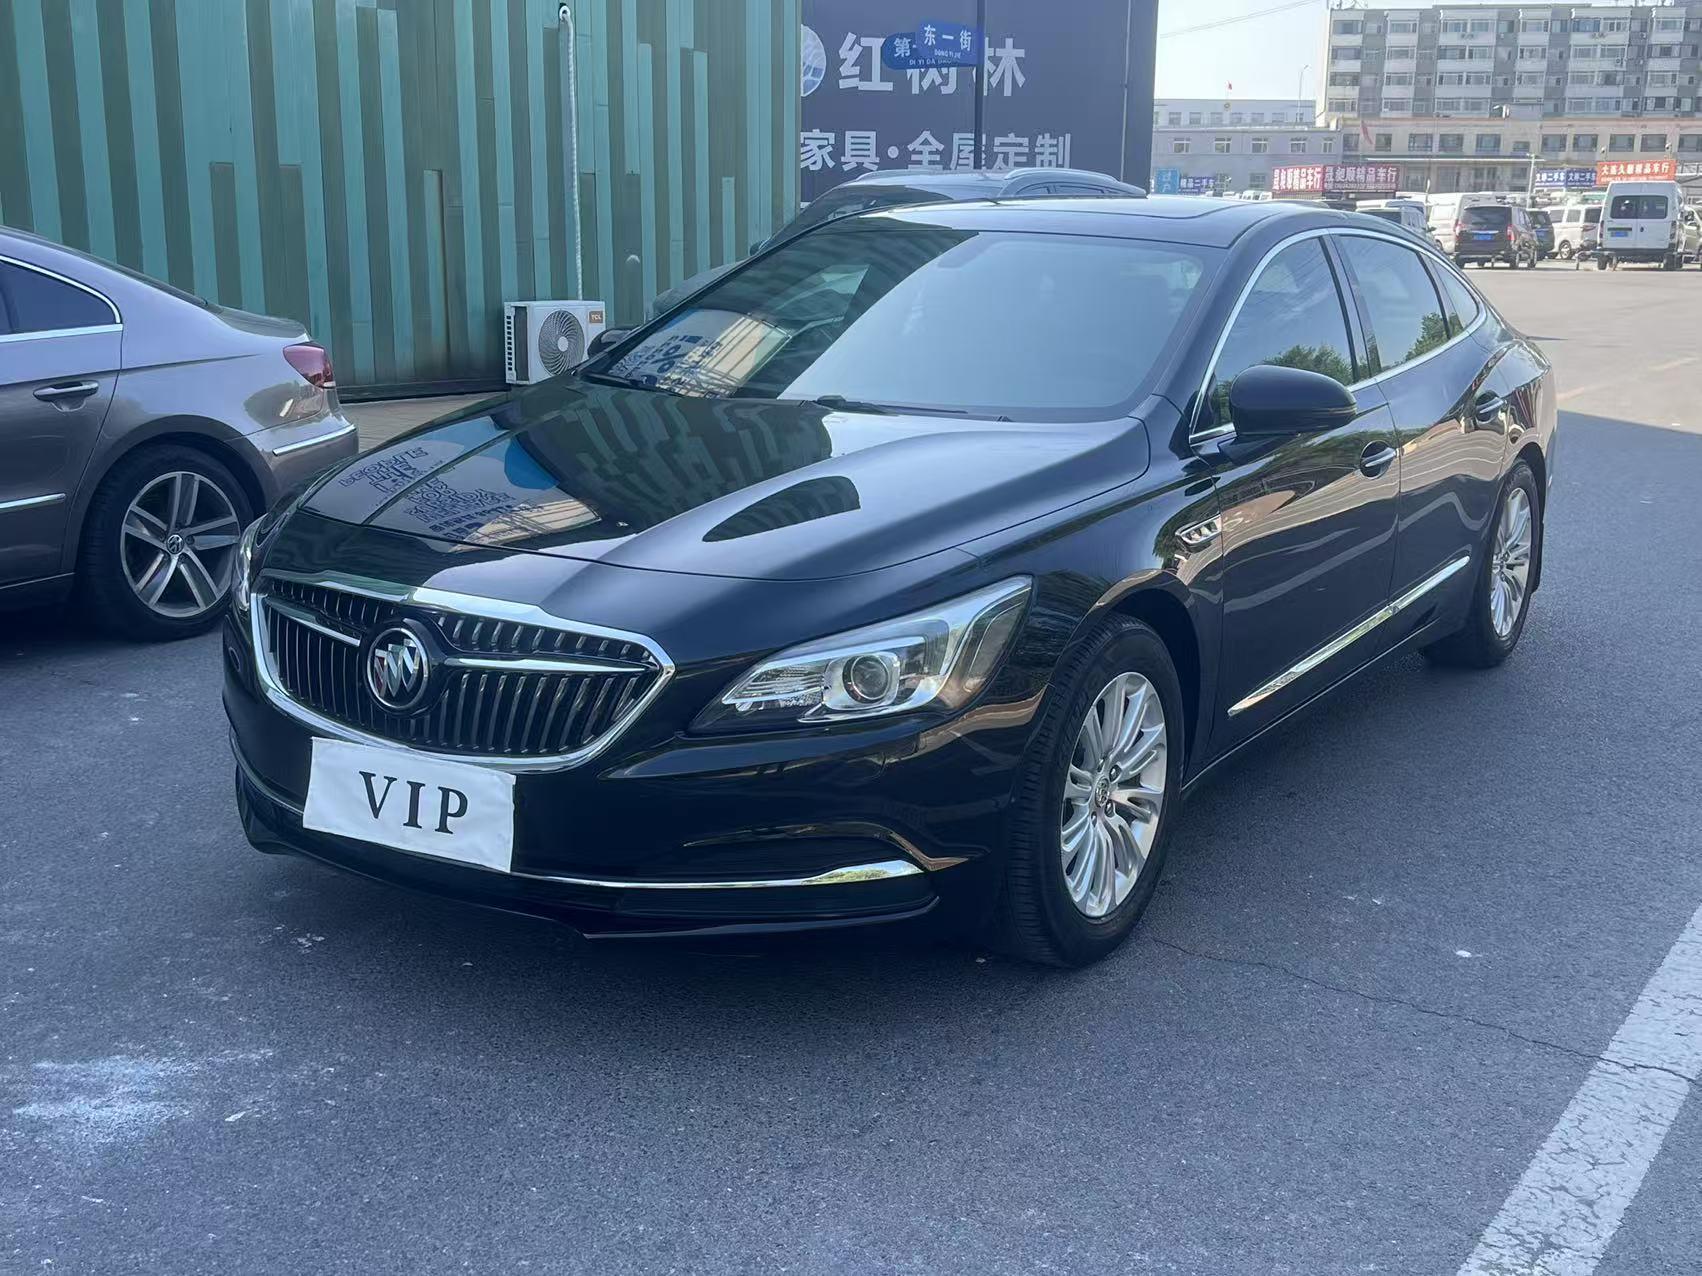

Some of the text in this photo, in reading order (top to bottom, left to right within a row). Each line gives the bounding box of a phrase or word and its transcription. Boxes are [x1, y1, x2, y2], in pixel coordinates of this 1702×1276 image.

[893, 37, 917, 58] 第
[923, 24, 972, 51] 东一街
[926, 57, 935, 65] DA
[358, 770, 468, 835] VIP
